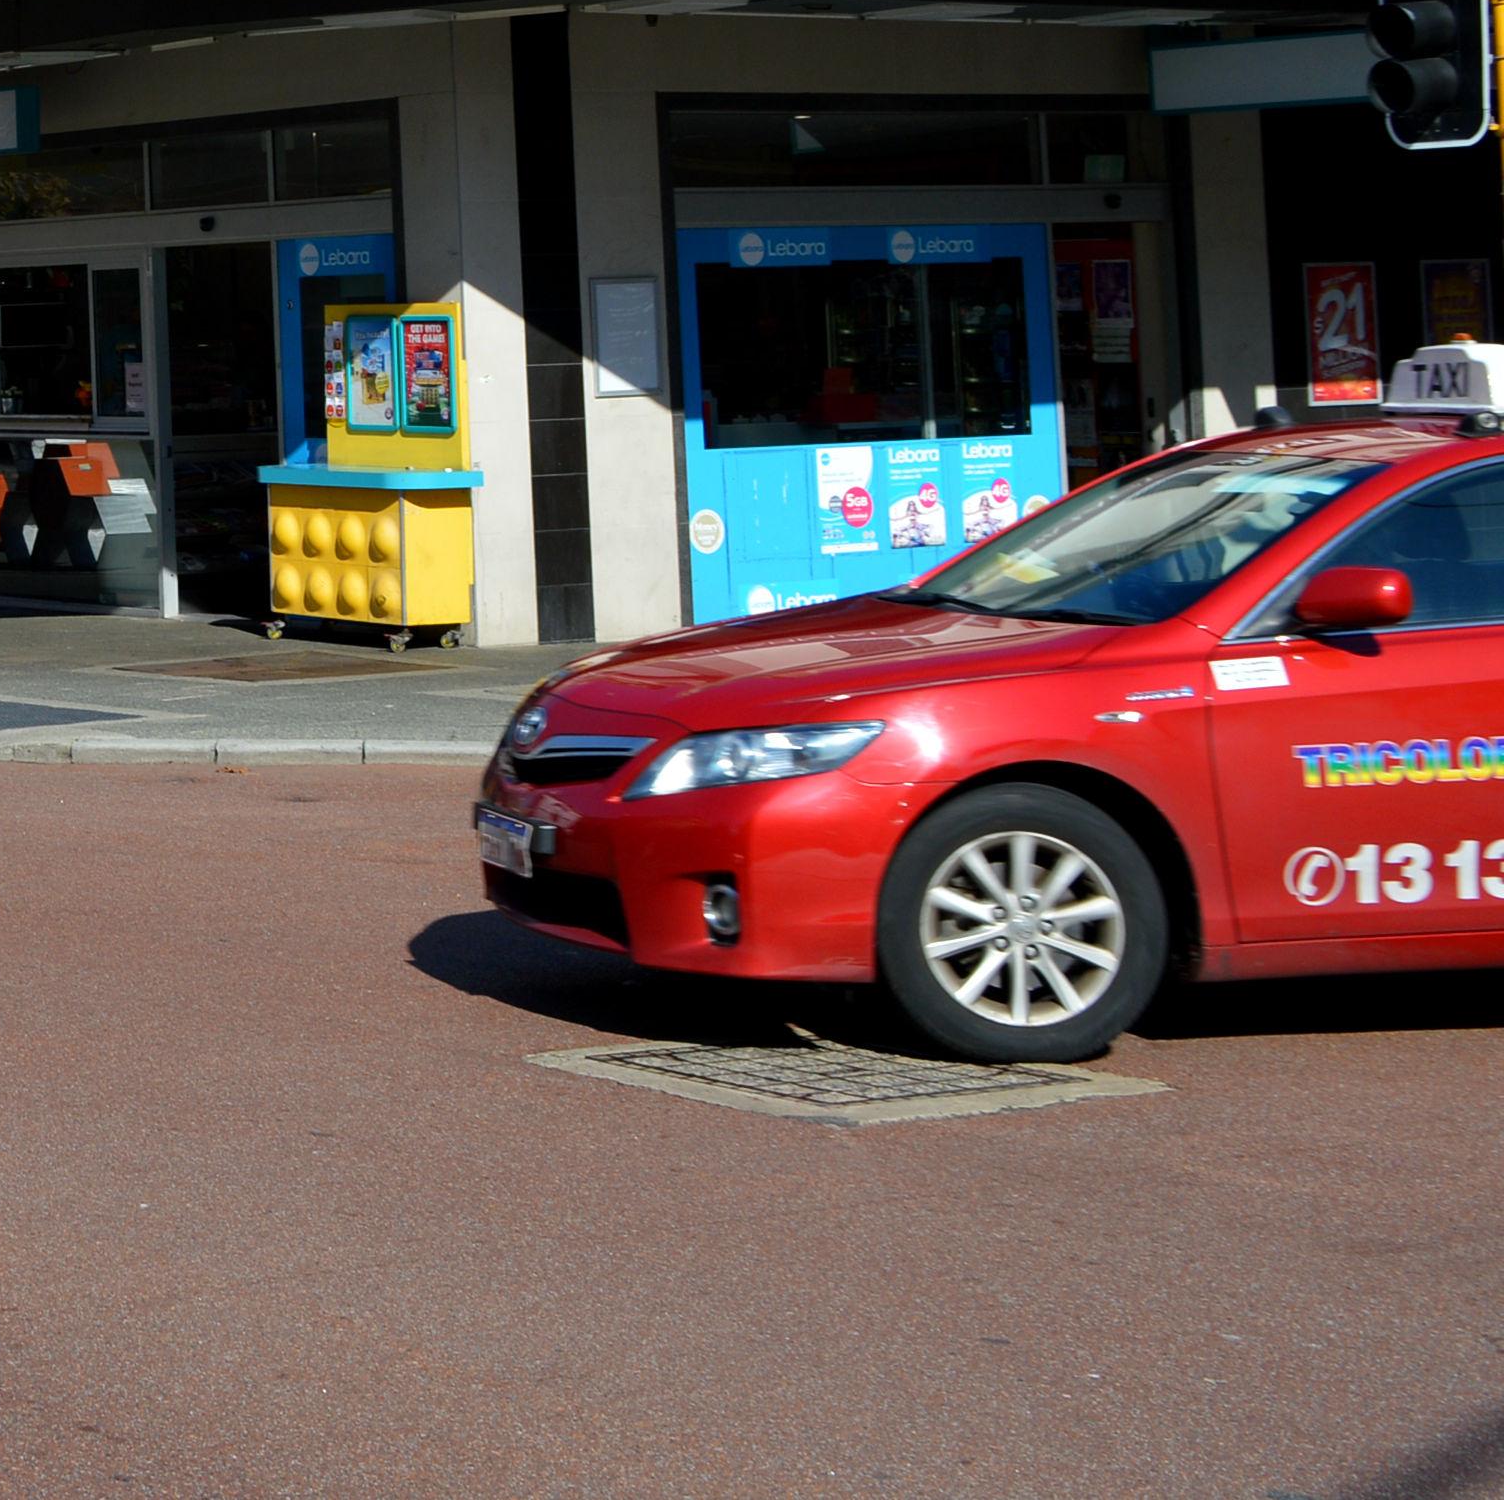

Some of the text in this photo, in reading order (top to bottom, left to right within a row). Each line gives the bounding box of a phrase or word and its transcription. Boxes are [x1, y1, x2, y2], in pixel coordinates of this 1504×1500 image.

[768, 239, 826, 257] Lebara
[918, 237, 974, 254] Lebara
[321, 248, 370, 267] Lebara
[1411, 362, 1469, 399] TAXI
[888, 447, 940, 464] Lebara
[961, 443, 1013, 460] Lebara
[919, 487, 937, 502] 4G
[992, 483, 1010, 497] 4G
[1344, 842, 1434, 905] 13
